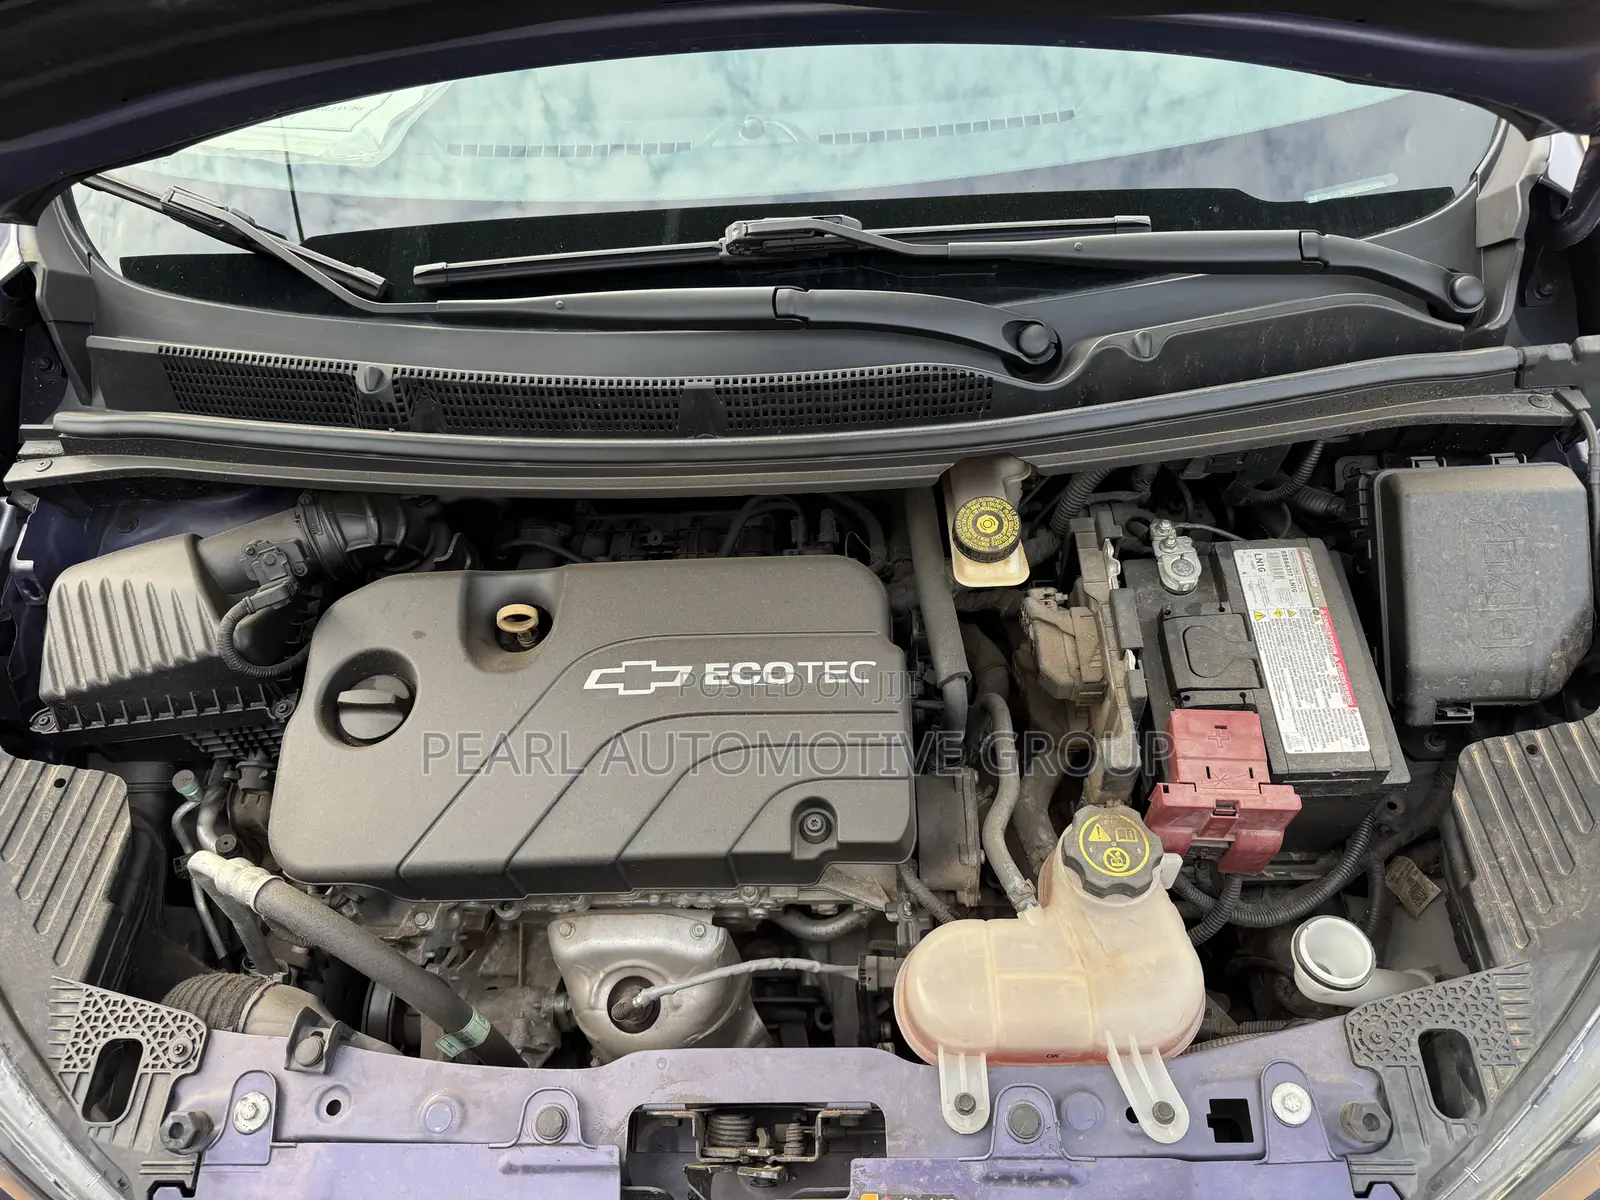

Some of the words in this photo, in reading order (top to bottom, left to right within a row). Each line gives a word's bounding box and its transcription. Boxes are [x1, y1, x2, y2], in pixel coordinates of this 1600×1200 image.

[1254, 553, 1266, 573] LN1G
[1288, 579, 1298, 593] LN1G
[705, 660, 877, 686] ECOTEC
